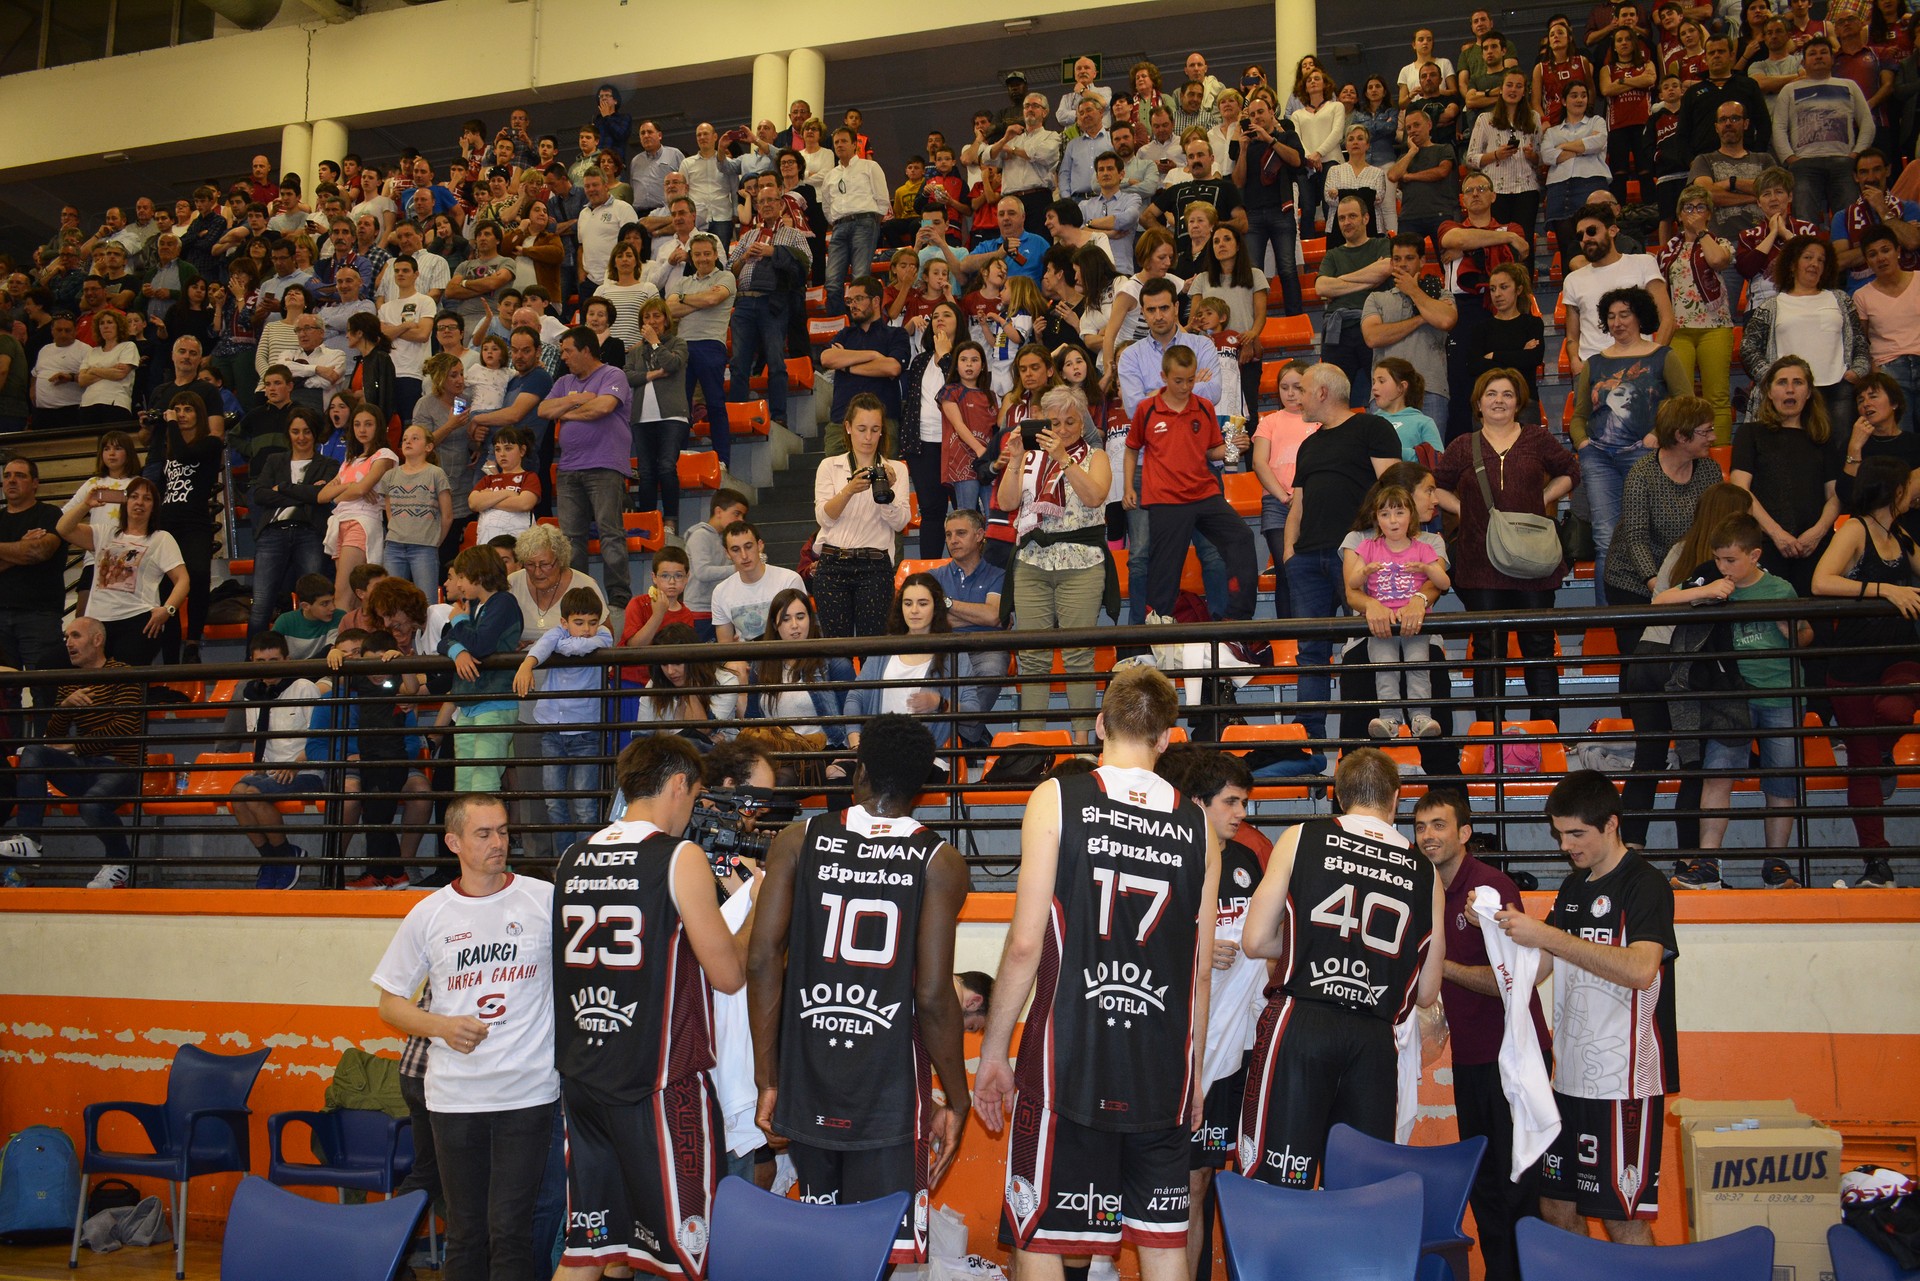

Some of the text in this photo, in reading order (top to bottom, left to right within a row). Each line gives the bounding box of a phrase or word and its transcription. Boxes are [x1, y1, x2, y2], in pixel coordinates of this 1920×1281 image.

[1557, 70, 1570, 80] 10
[1082, 805, 1193, 844] SHERMAN
[573, 850, 639, 867] ANDER
[815, 835, 848, 854] DE
[1087, 834, 1183, 868] gipuzkoa
[1325, 834, 1417, 871] DEZELSKI
[564, 875, 640, 894] gipuzkoa
[817, 862, 914, 886] gipuzkoa
[1324, 855, 1414, 891] gipuzkoa
[1093, 867, 1171, 944] 17
[1310, 883, 1411, 957] 40
[562, 905, 643, 968] 23
[821, 892, 900, 967] 10
[457, 943, 517, 972] IRAURGI
[447, 964, 538, 991] URREA GARA!!!
[1083, 960, 1169, 1003] LOIOLA
[570, 986, 638, 1019] LOIOLA
[800, 982, 902, 1021] LOIOLA
[1323, 983, 1374, 1006] HOTELA
[579, 1018, 620, 1033] HOTELA
[811, 1014, 874, 1036] HOTELA
[674, 1078, 697, 1176] RAURGI
[1266, 1144, 1312, 1178] zaher
[1578, 1133, 1599, 1165] 3
[1281, 1177, 1307, 1185] GRUPO
[1712, 1150, 1828, 1189] INSALUS
